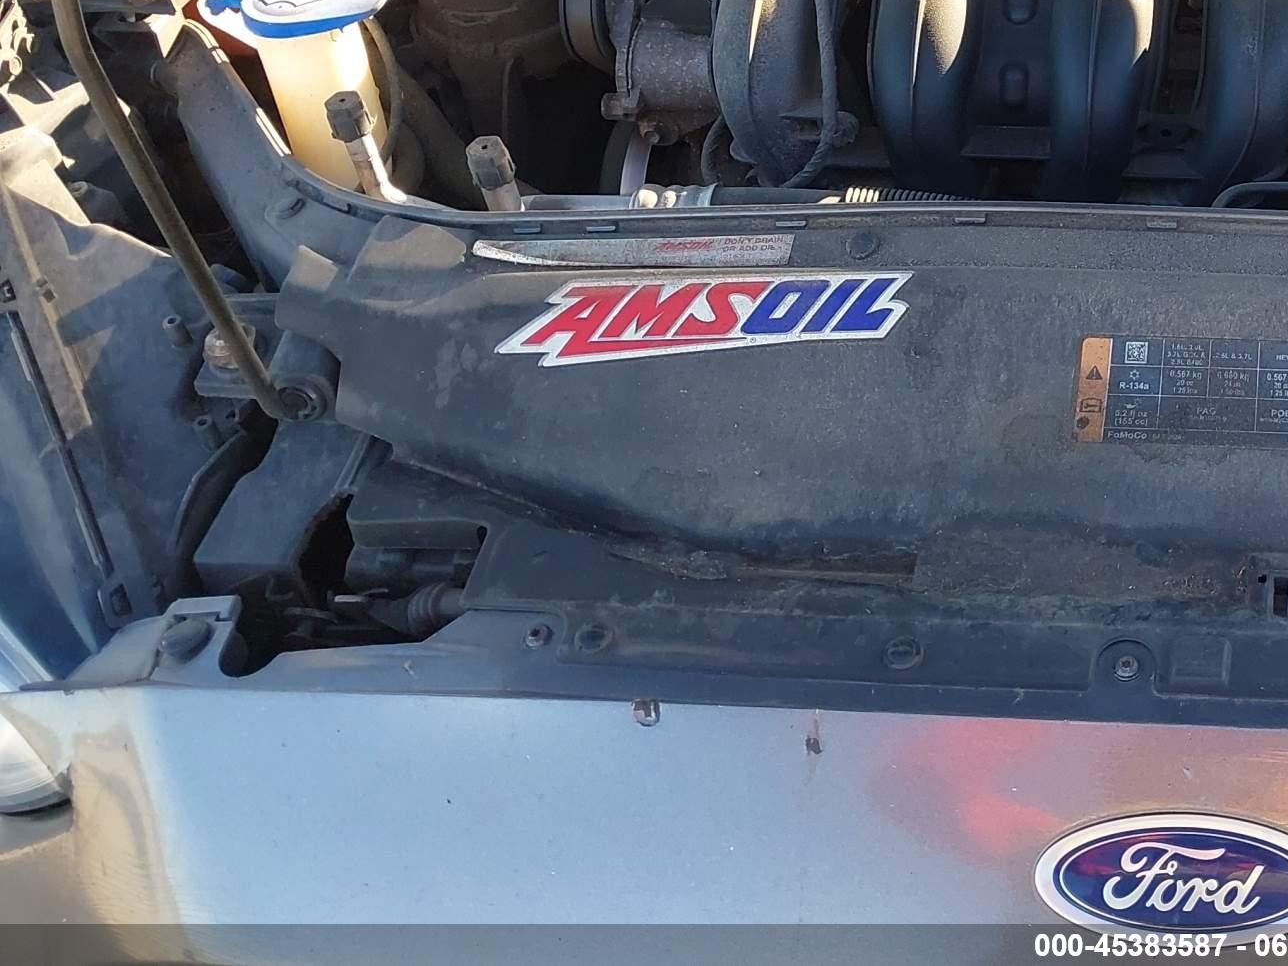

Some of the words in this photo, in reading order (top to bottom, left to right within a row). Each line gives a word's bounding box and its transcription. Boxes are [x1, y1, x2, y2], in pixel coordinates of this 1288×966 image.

[754, 236, 784, 244] DRAIN
[515, 276, 905, 361] AMSOIL
[1266, 373, 1287, 382] 0.567
[1119, 381, 1150, 390] R-134a
[1102, 841, 1264, 916] Ford
